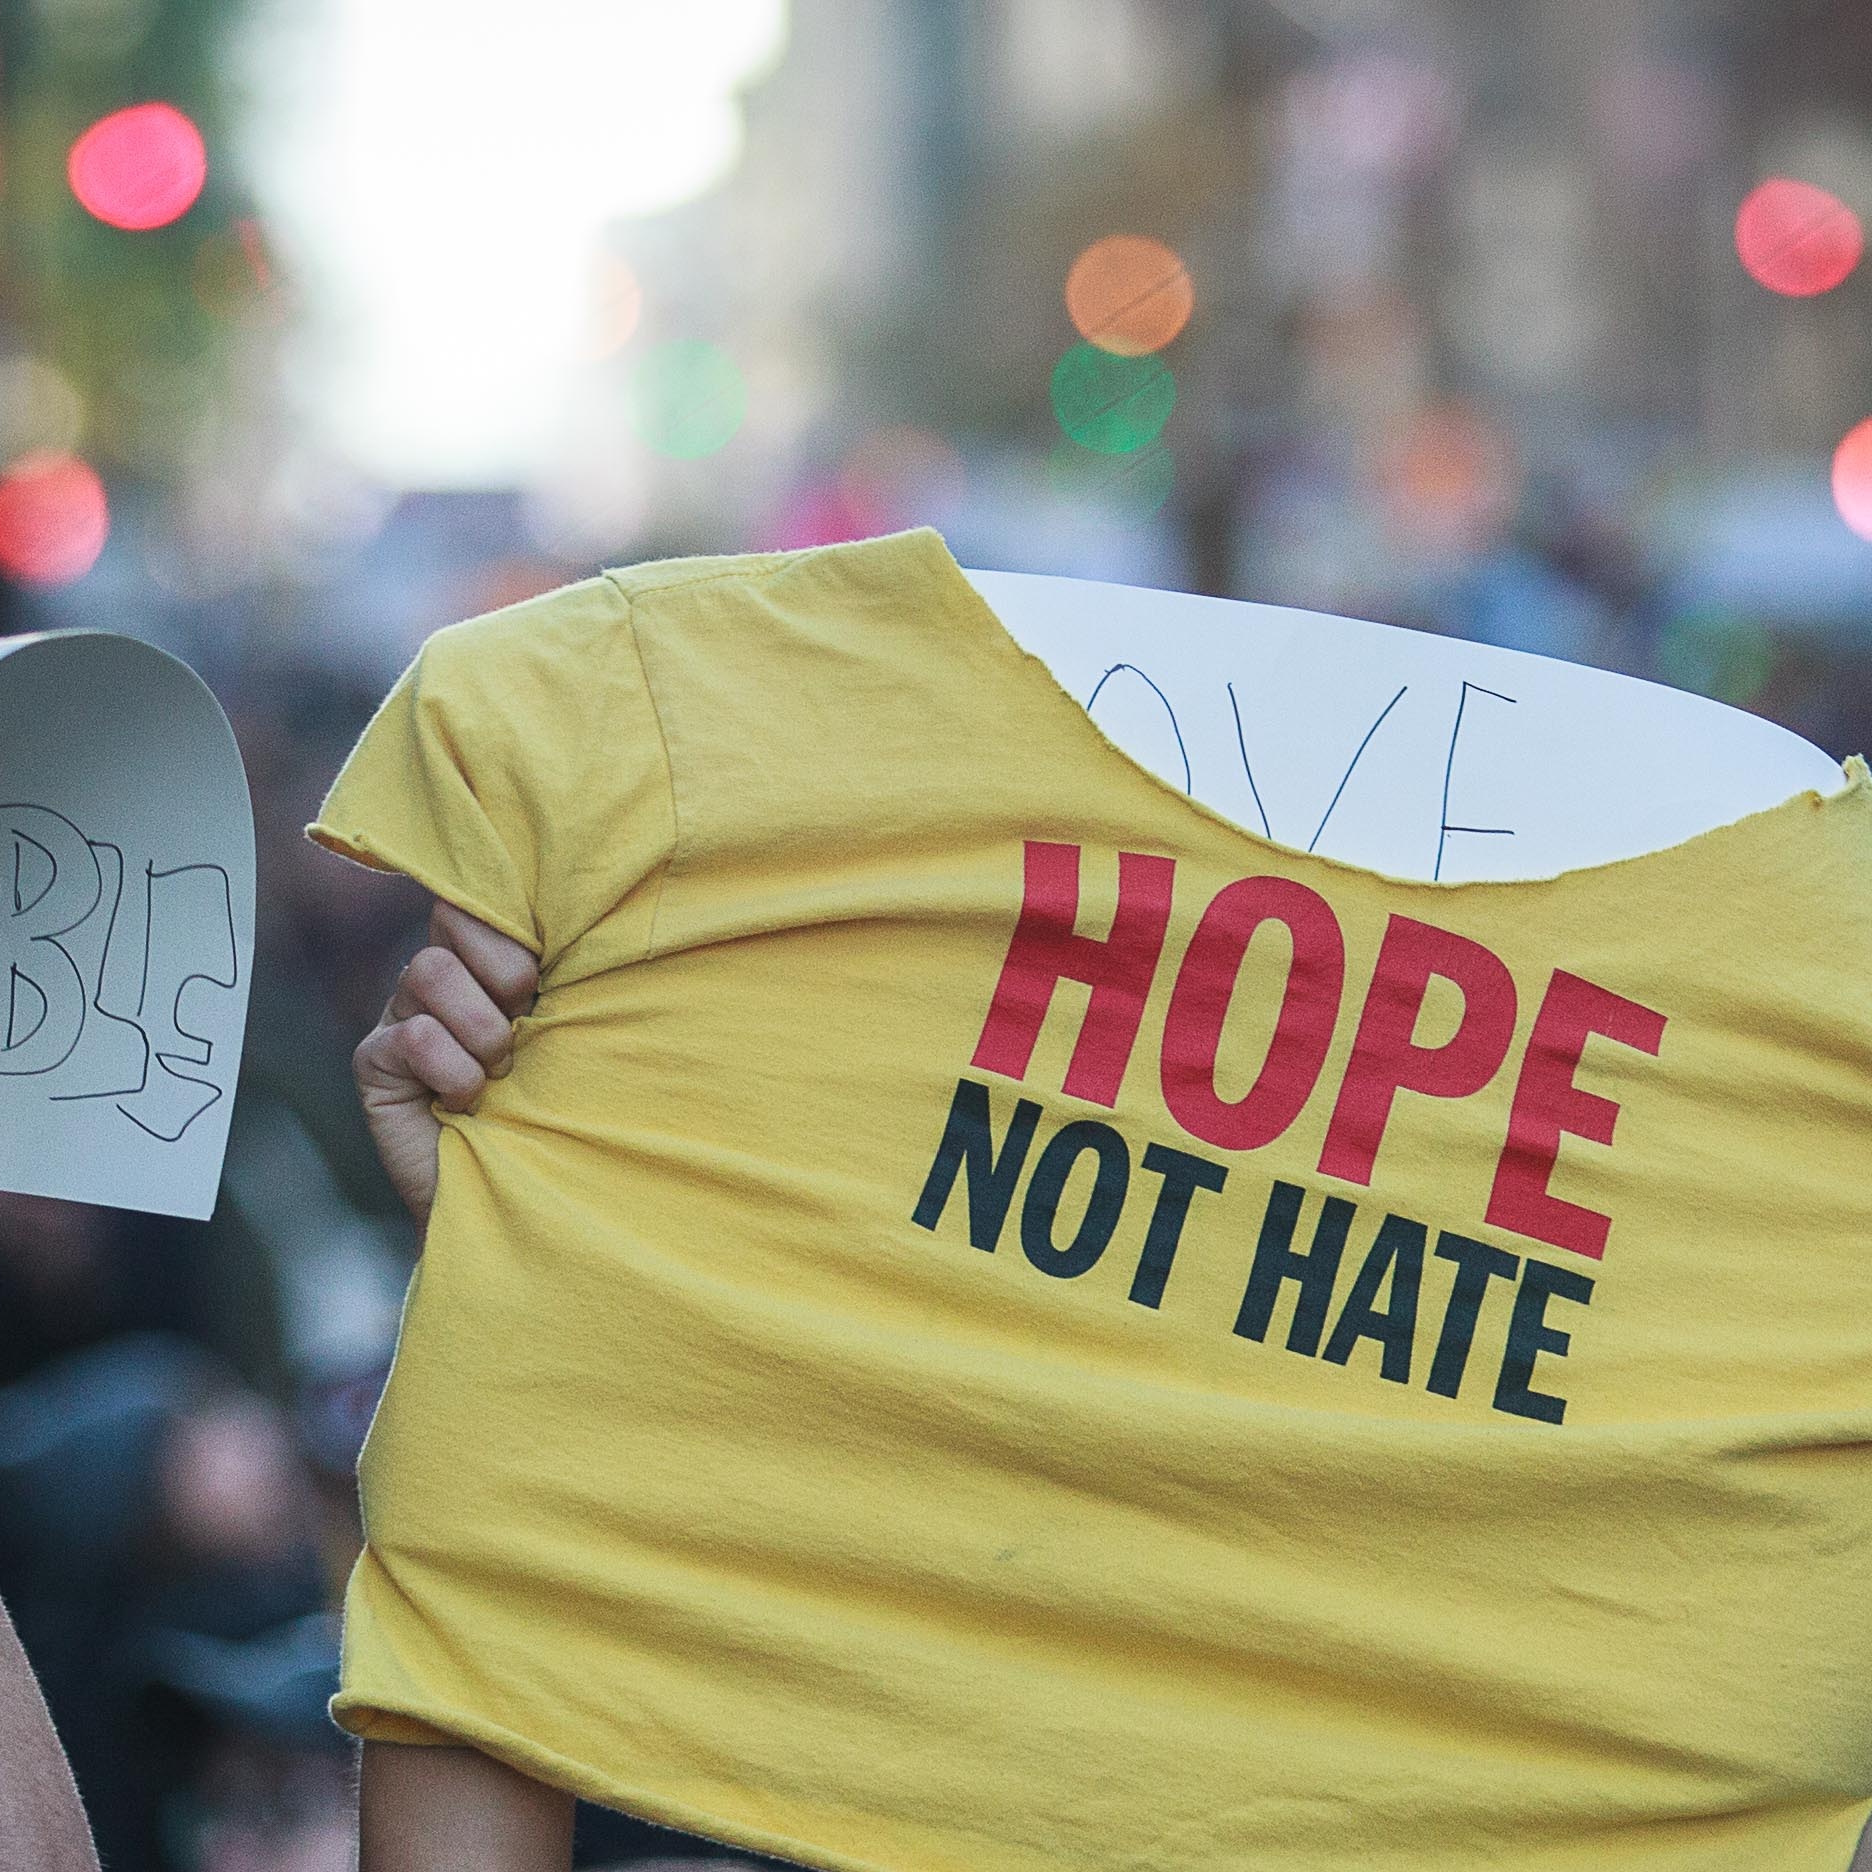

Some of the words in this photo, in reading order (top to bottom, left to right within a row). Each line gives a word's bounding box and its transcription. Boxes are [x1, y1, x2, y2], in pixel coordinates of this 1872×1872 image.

[969, 840, 1669, 1261] HOPE
[910, 1077, 1230, 1311] NOT
[1232, 1182, 1596, 1426] HATE
